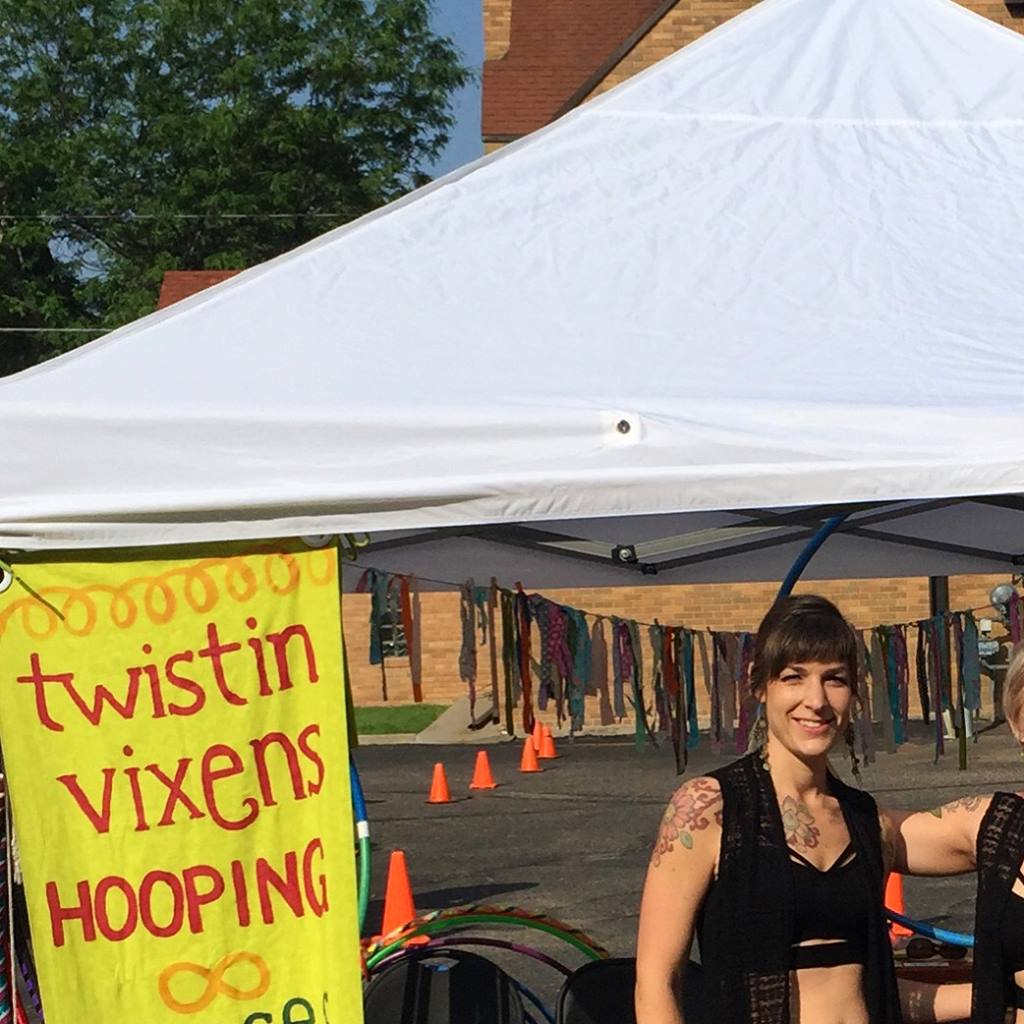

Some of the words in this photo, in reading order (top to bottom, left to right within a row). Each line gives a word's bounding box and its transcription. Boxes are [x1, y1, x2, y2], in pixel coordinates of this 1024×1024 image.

[17, 617, 319, 731] twistin
[56, 724, 325, 834] vixens
[46, 838, 328, 946] HOOPING
